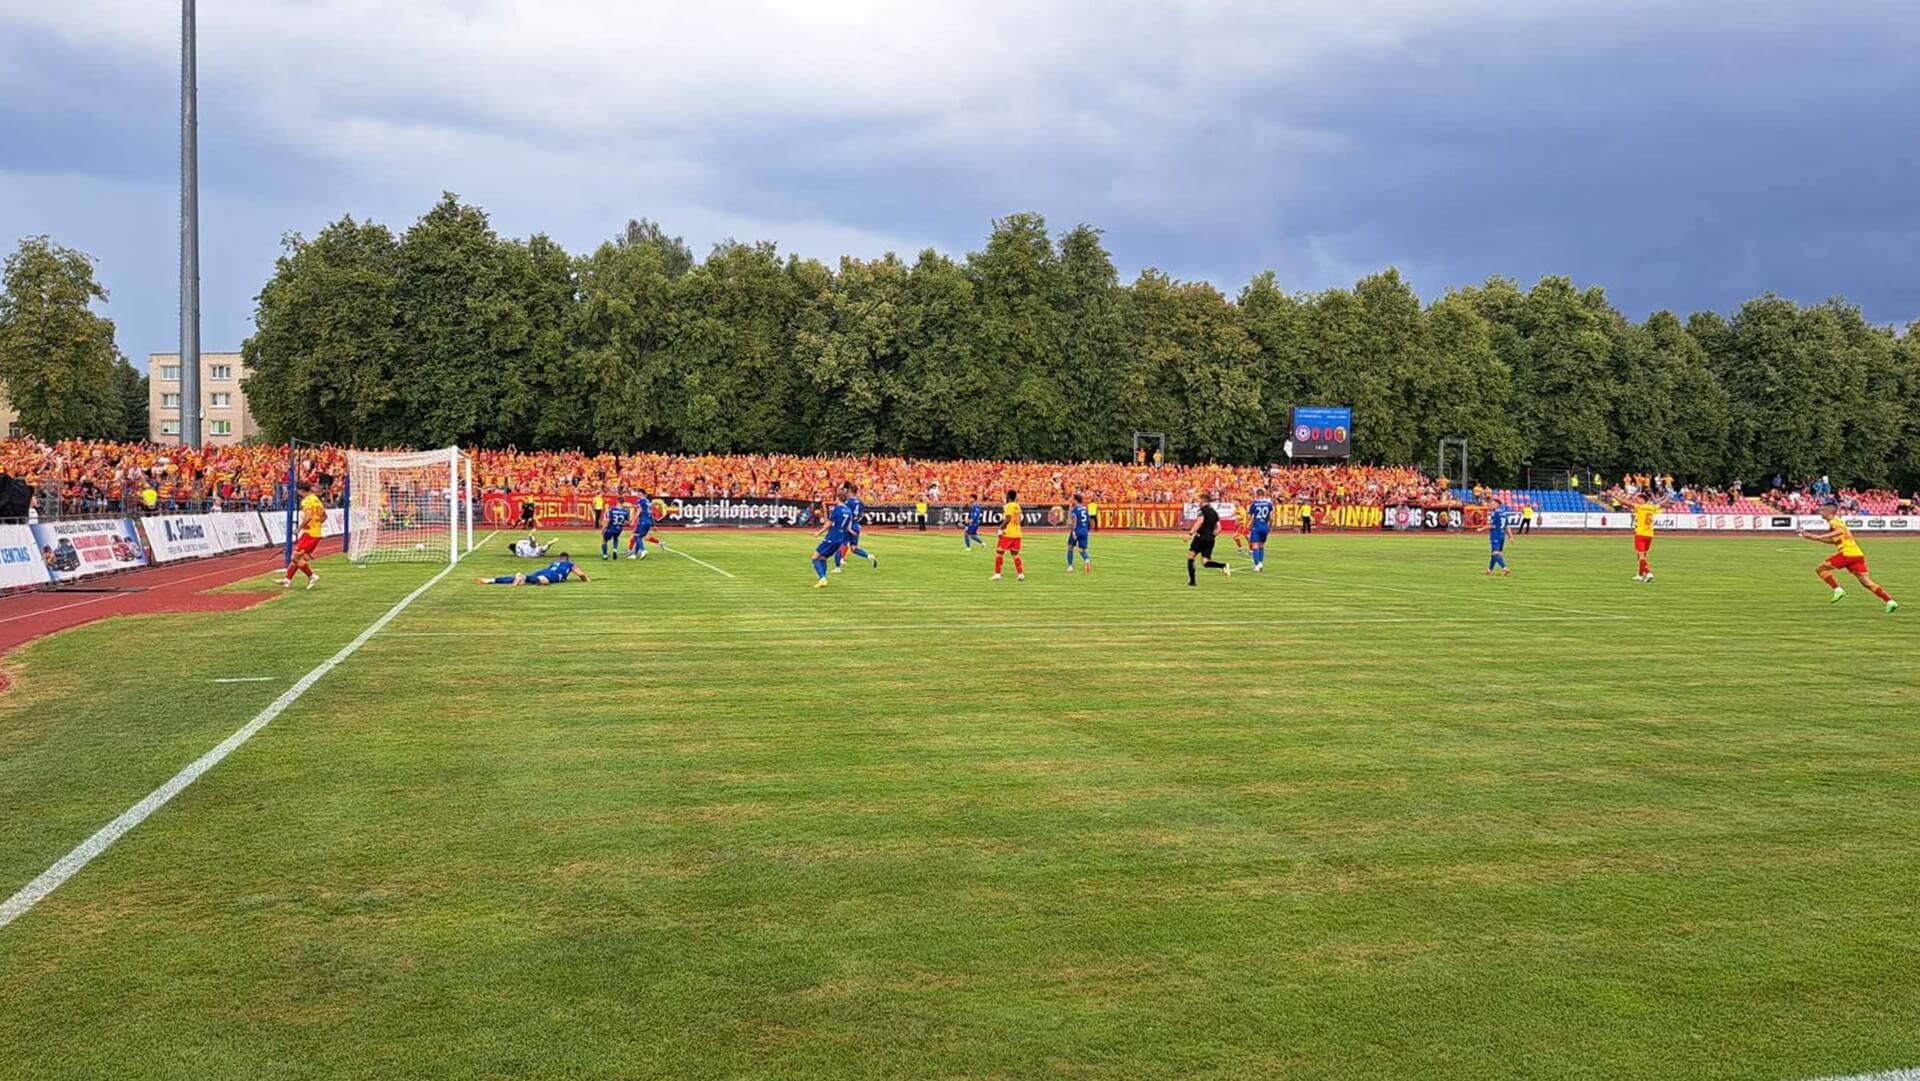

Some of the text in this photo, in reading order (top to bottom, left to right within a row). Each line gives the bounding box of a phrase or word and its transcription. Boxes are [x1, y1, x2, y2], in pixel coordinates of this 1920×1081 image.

[1312, 427, 1333, 441] 0 0
[1080, 511, 1087, 522] 5
[1256, 506, 1269, 519] 20
[841, 514, 850, 527] 7
